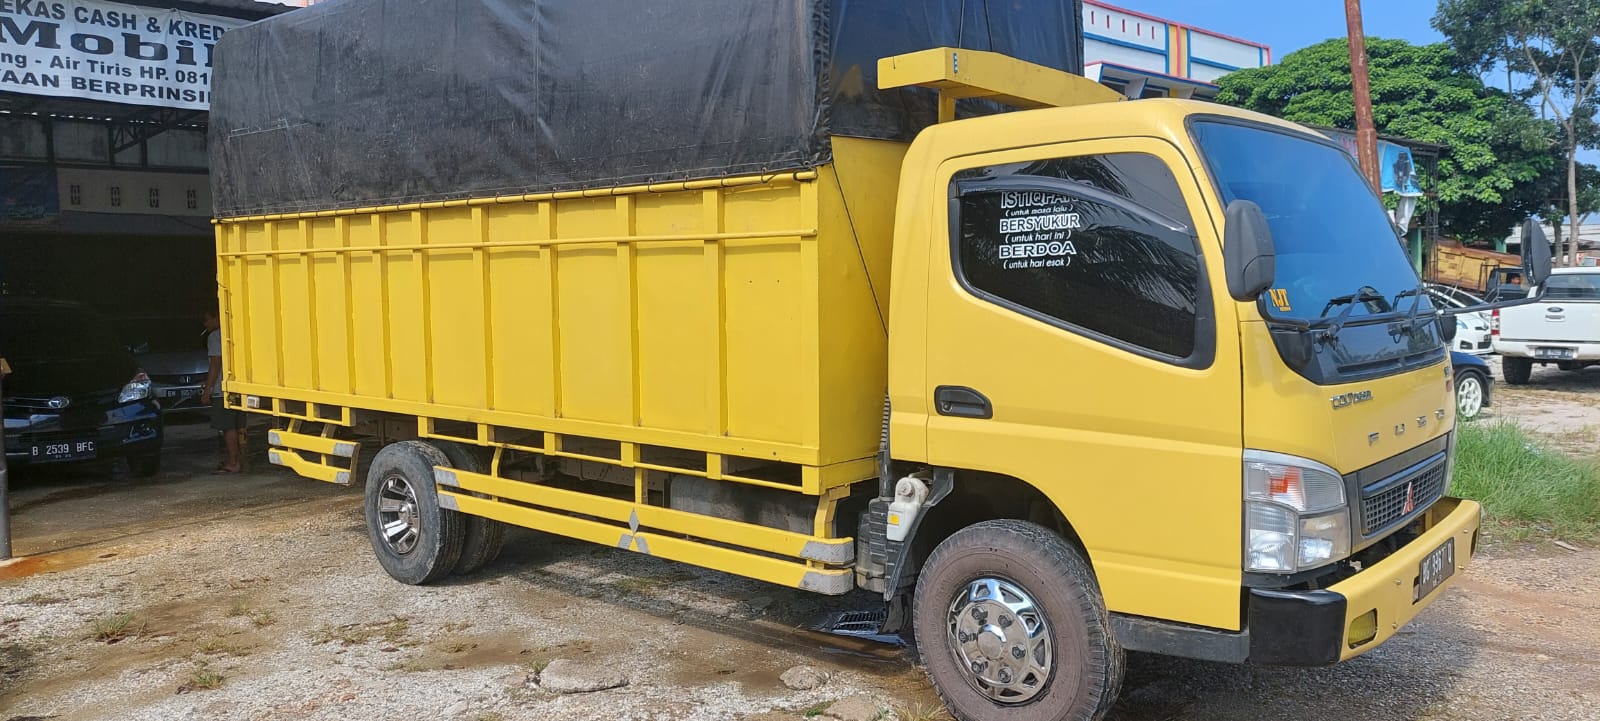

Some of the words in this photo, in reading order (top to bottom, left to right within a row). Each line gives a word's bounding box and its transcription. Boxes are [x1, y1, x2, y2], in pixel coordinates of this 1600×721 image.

[74, 6, 136, 30] CASH
[147, 17, 161, 33] &
[169, 19, 230, 41] KRED
[50, 55, 80, 70] Air
[86, 59, 132, 77] Tiris
[140, 66, 168, 80] HP.
[175, 70, 208, 85] 081
[0, 69, 60, 88] AAN
[71, 76, 211, 104] BERPRINSI
[1000, 213, 1080, 233] BERSYUKUR
[1011, 232, 1033, 242] untuk
[1035, 231, 1053, 241] hari
[1054, 231, 1065, 240] ini
[999, 241, 1077, 259] BERDOA
[1009, 258, 1028, 268] untuk
[1029, 258, 1045, 268] hari
[1046, 257, 1065, 266] esok
[32, 446, 39, 456] B
[46, 443, 70, 455] 2539
[76, 441, 94, 453] BFC
